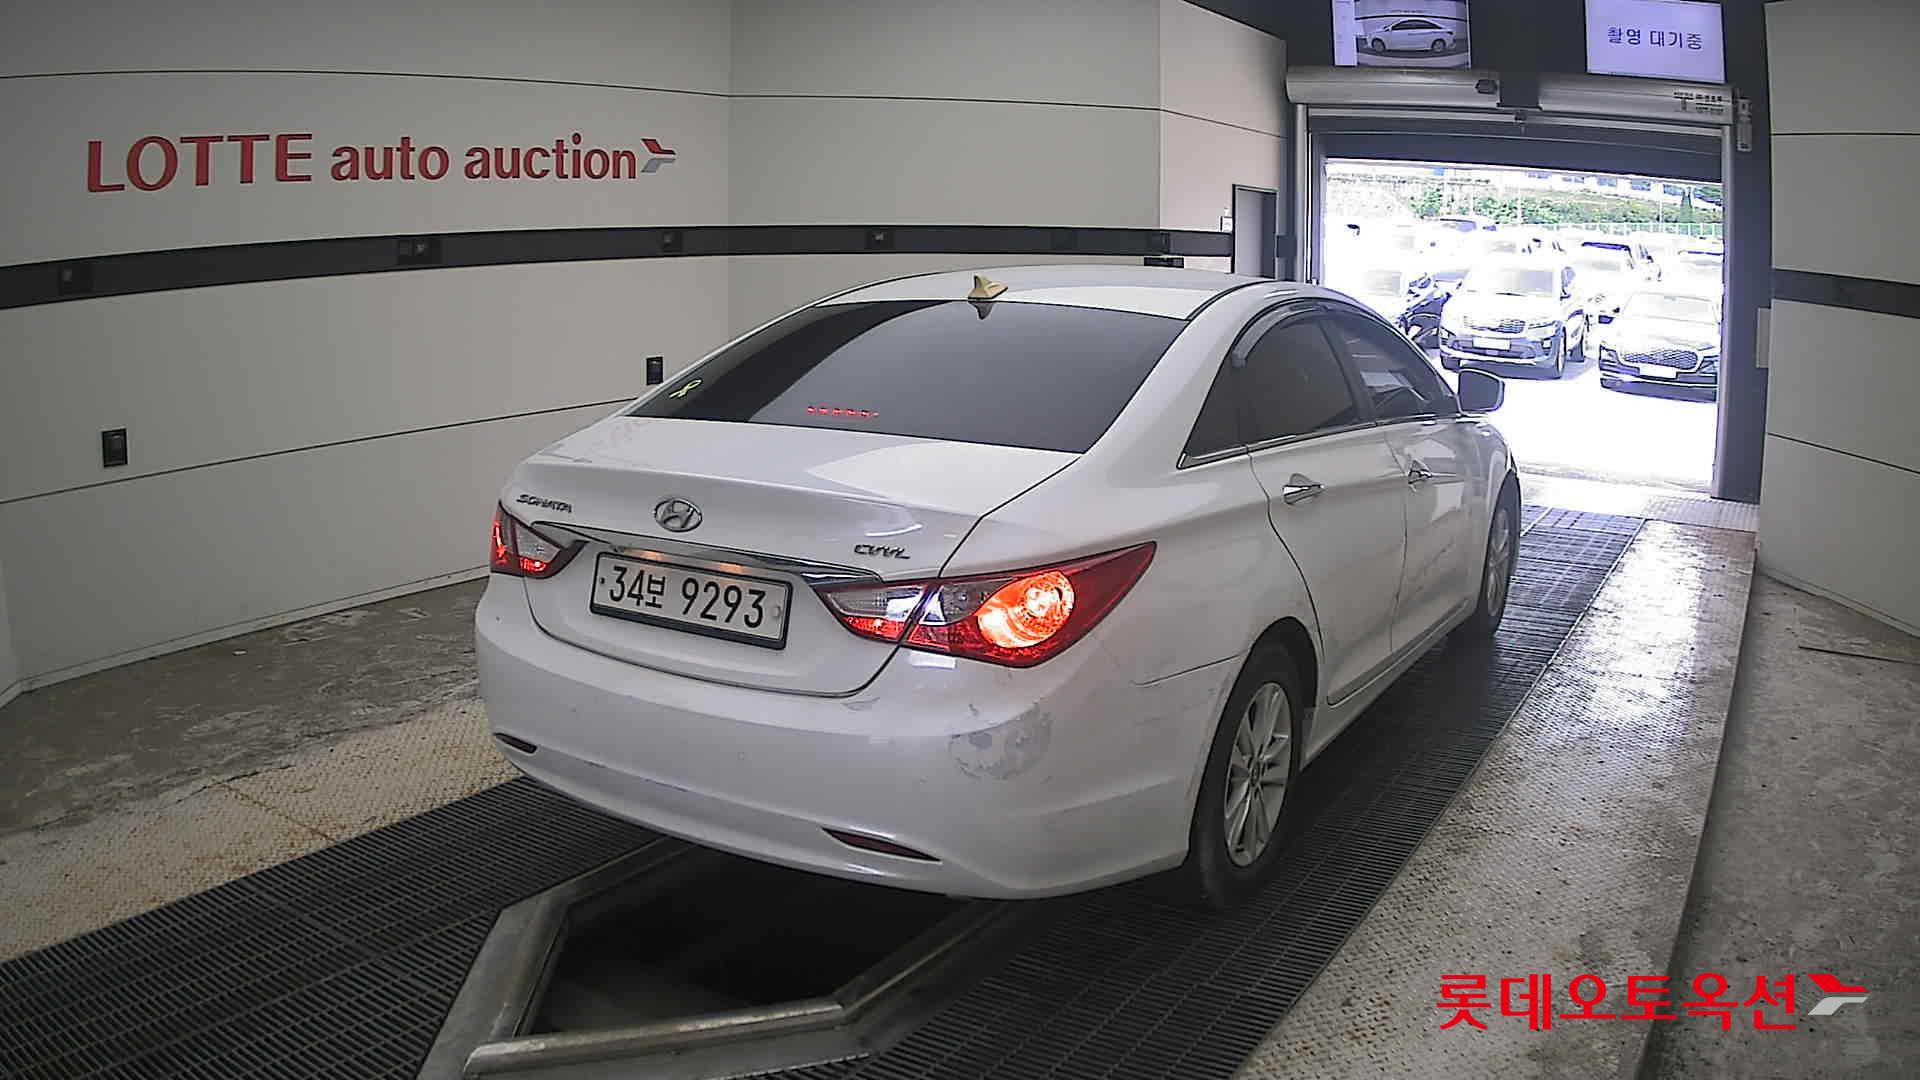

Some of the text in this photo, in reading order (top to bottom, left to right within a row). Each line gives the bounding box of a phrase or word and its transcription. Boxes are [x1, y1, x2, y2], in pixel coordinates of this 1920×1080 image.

[1607, 26, 1703, 50] 촬영 대기중
[86, 132, 638, 193] LOTTE auto auction
[515, 493, 573, 514] SONATA
[609, 565, 766, 628] 34보 9293
